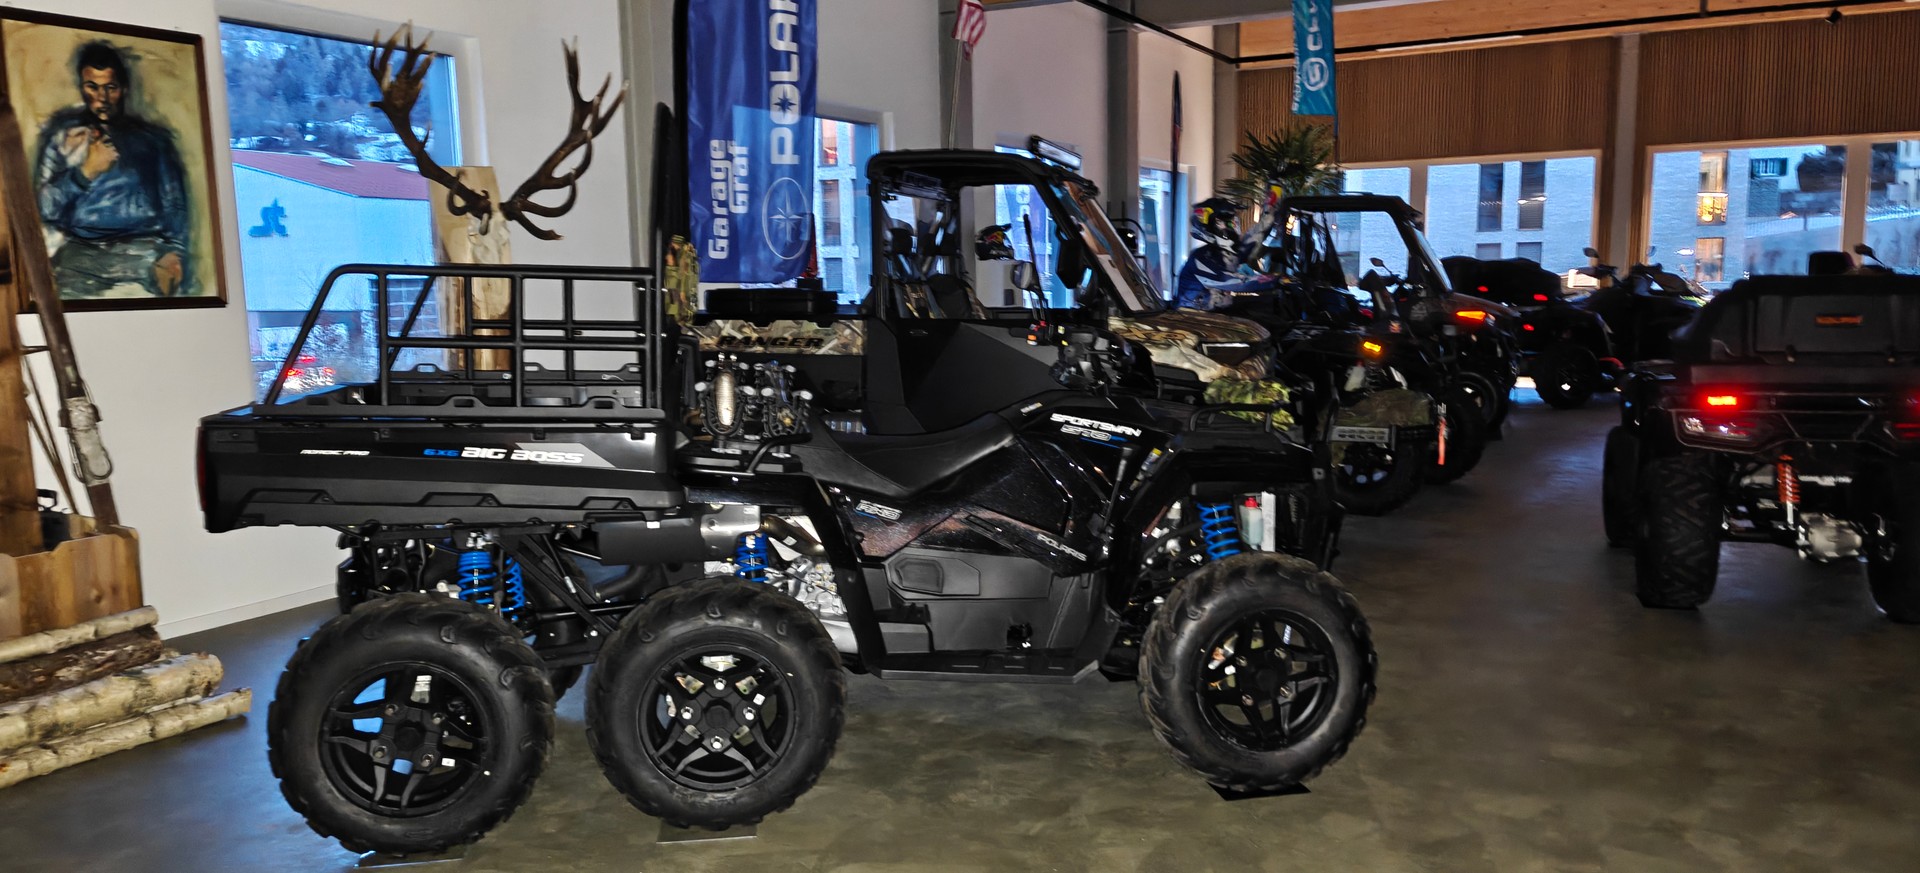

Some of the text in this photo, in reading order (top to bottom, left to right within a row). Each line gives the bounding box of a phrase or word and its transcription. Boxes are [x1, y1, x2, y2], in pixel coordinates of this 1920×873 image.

[768, 0, 801, 165] POLA
[727, 139, 749, 214] Graf
[708, 139, 731, 259] Garage
[717, 335, 825, 347] RANGER
[1050, 413, 1142, 437] SPORTSMAN
[461, 446, 507, 459] BIG
[511, 449, 585, 464] BOSS
[1037, 533, 1087, 562] POLARIS
